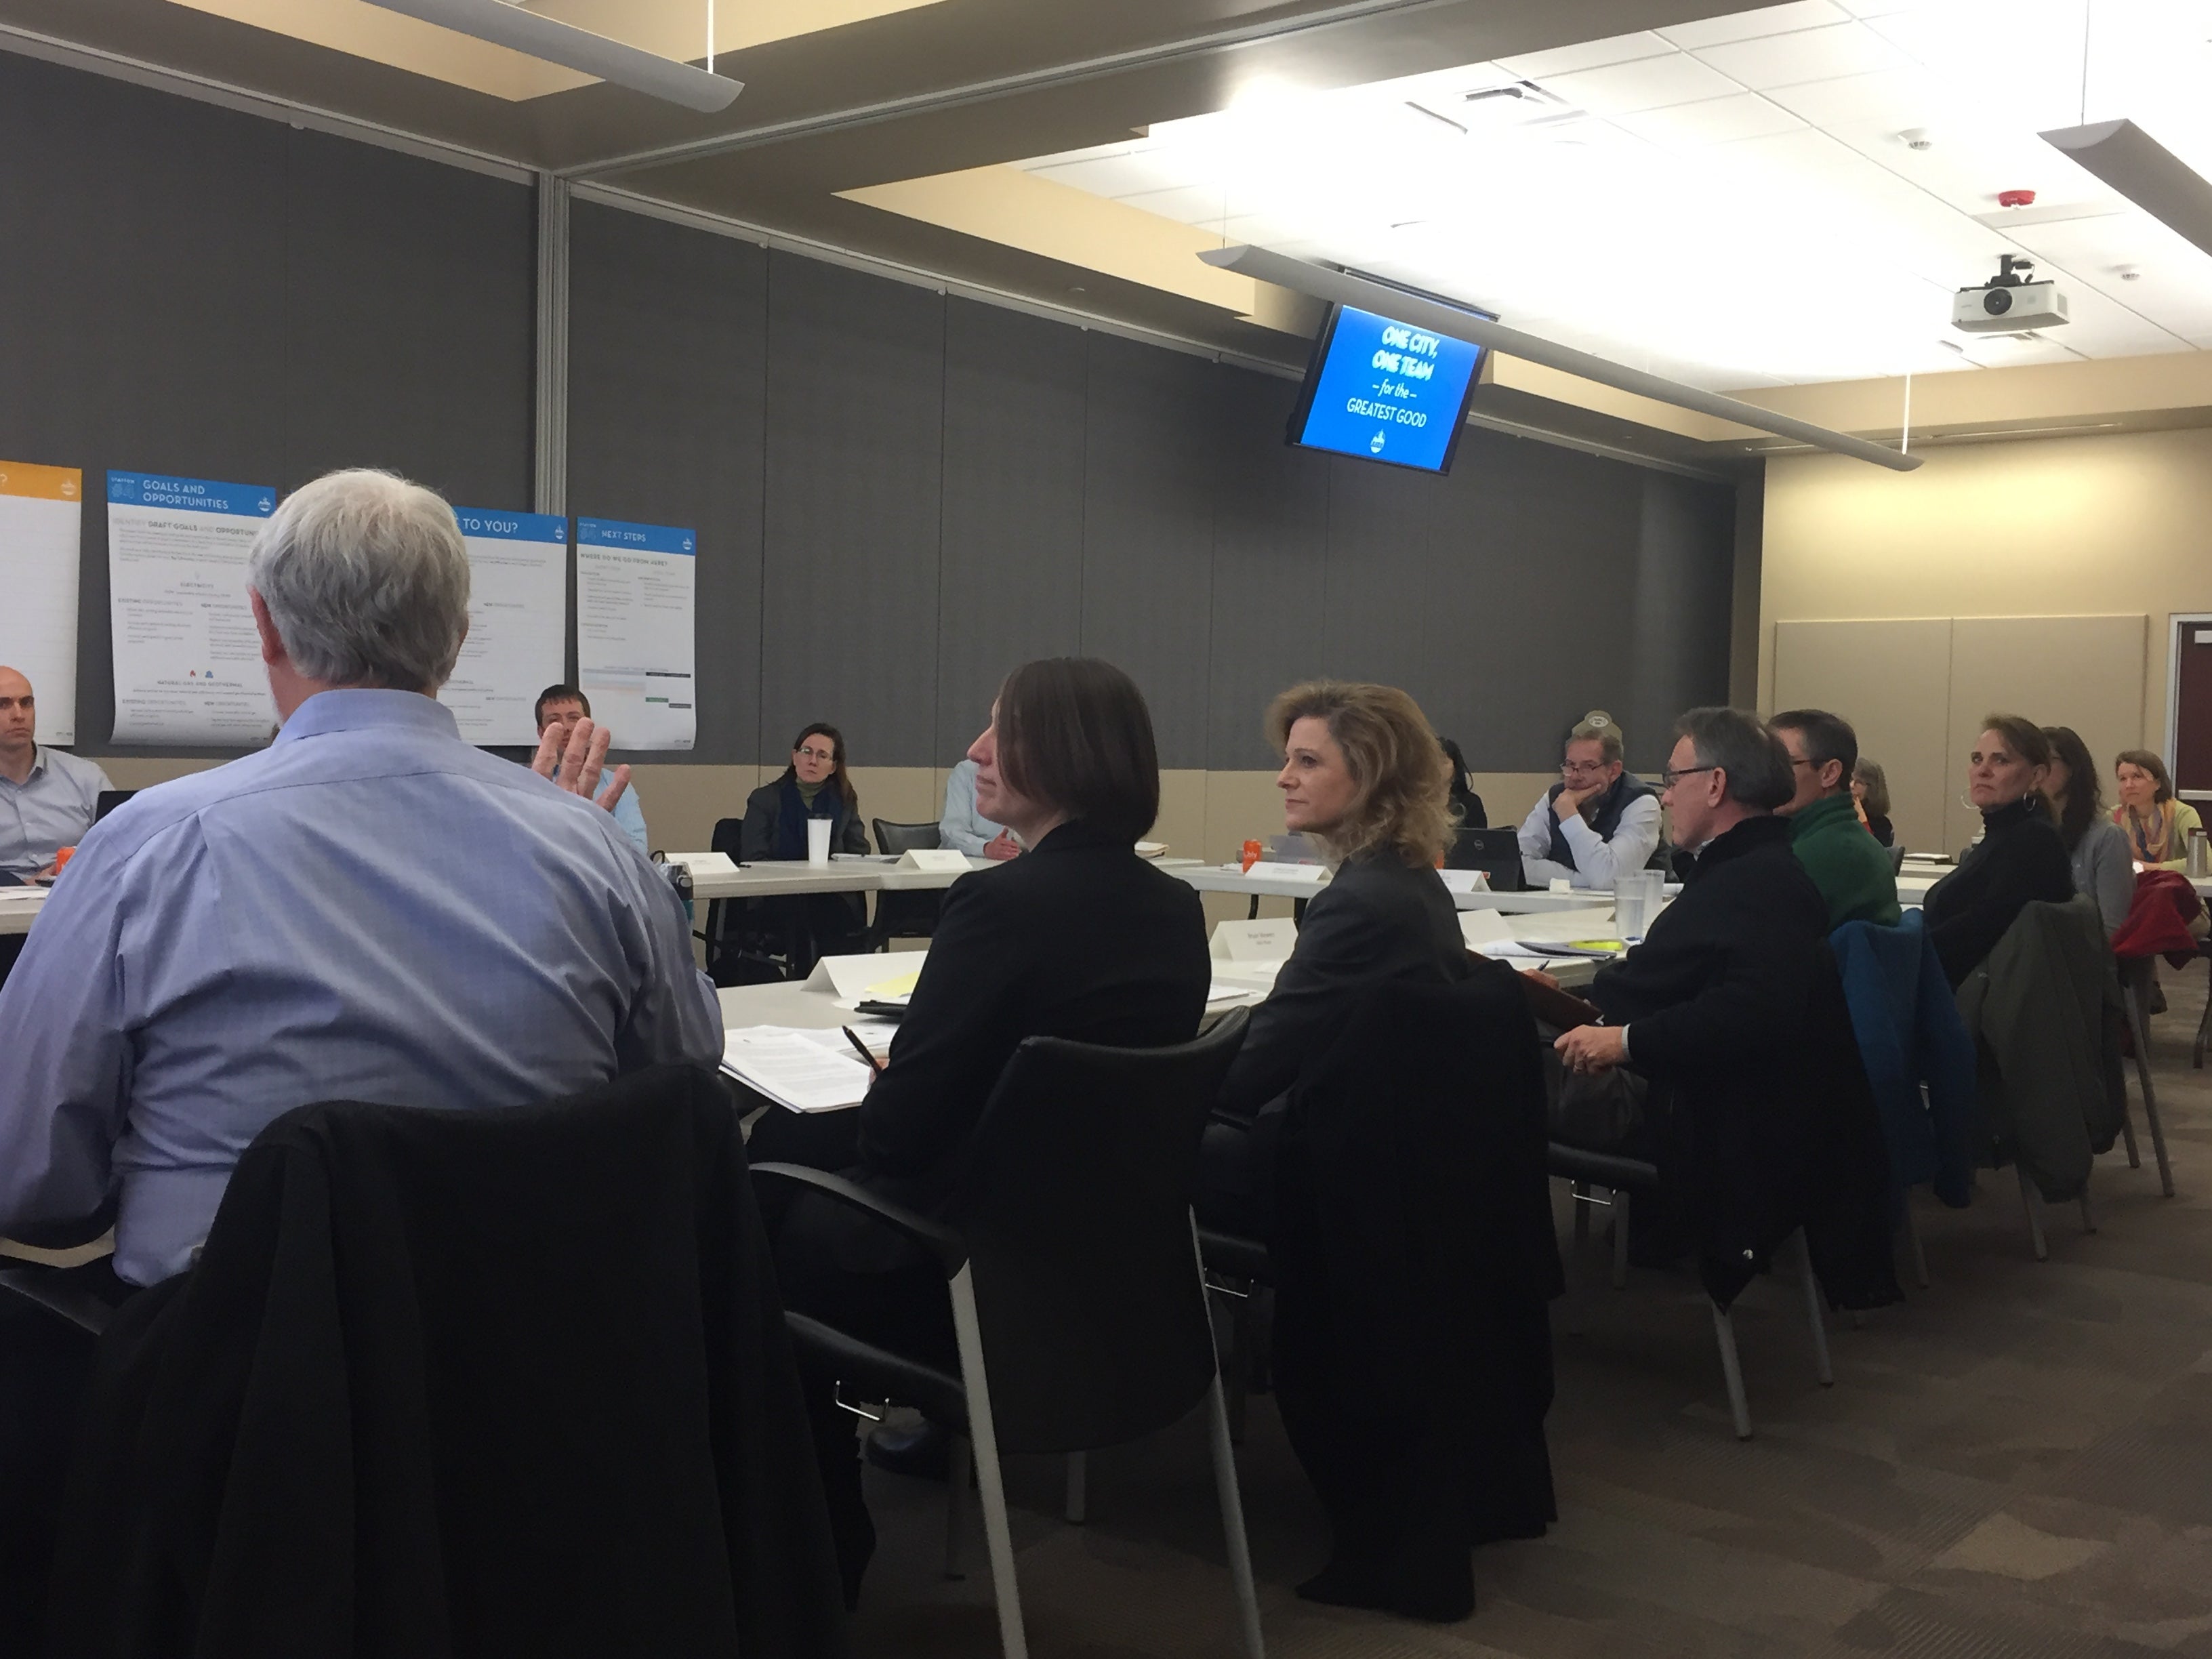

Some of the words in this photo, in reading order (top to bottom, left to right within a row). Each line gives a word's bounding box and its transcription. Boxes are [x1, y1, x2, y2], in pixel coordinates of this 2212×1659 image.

[1382, 325, 1411, 349] ONE
[1409, 333, 1440, 359] CITY,
[1372, 350, 1402, 373] ONE
[1399, 356, 1435, 381] TEAM
[1347, 397, 1397, 420] GREATEST
[1396, 409, 1427, 428] GOOD
[143, 480, 180, 492] GOALS
[182, 485, 205, 495] AND
[143, 492, 228, 510] OPPORTUNITIES
[463, 518, 480, 530] TO
[484, 520, 518, 533] YOU?
[601, 529, 622, 539] NEXT
[623, 532, 646, 542] STEPS
